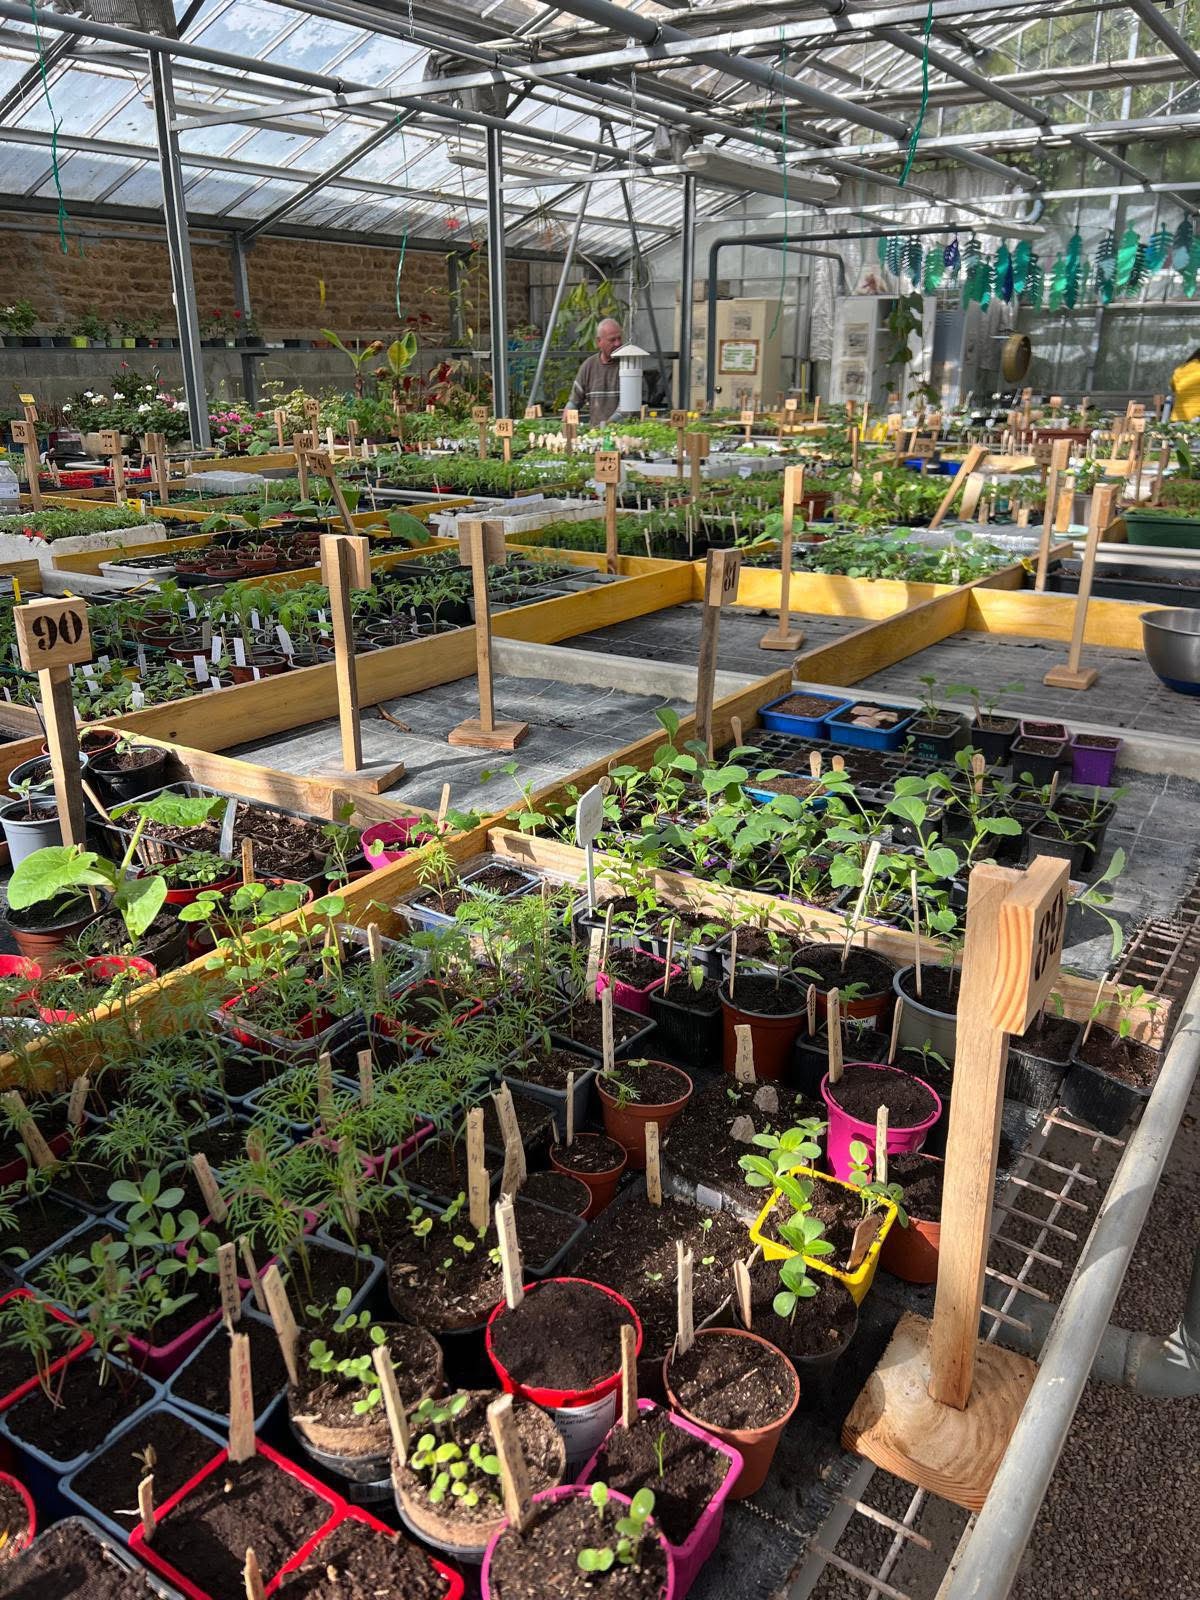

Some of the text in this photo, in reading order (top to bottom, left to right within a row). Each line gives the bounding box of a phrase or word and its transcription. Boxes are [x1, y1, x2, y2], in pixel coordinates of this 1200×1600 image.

[498, 421, 509, 432] 61
[599, 456, 617, 471] 75
[723, 560, 736, 592] 81
[32, 610, 83, 651] 90
[1034, 887, 1064, 982] 89
